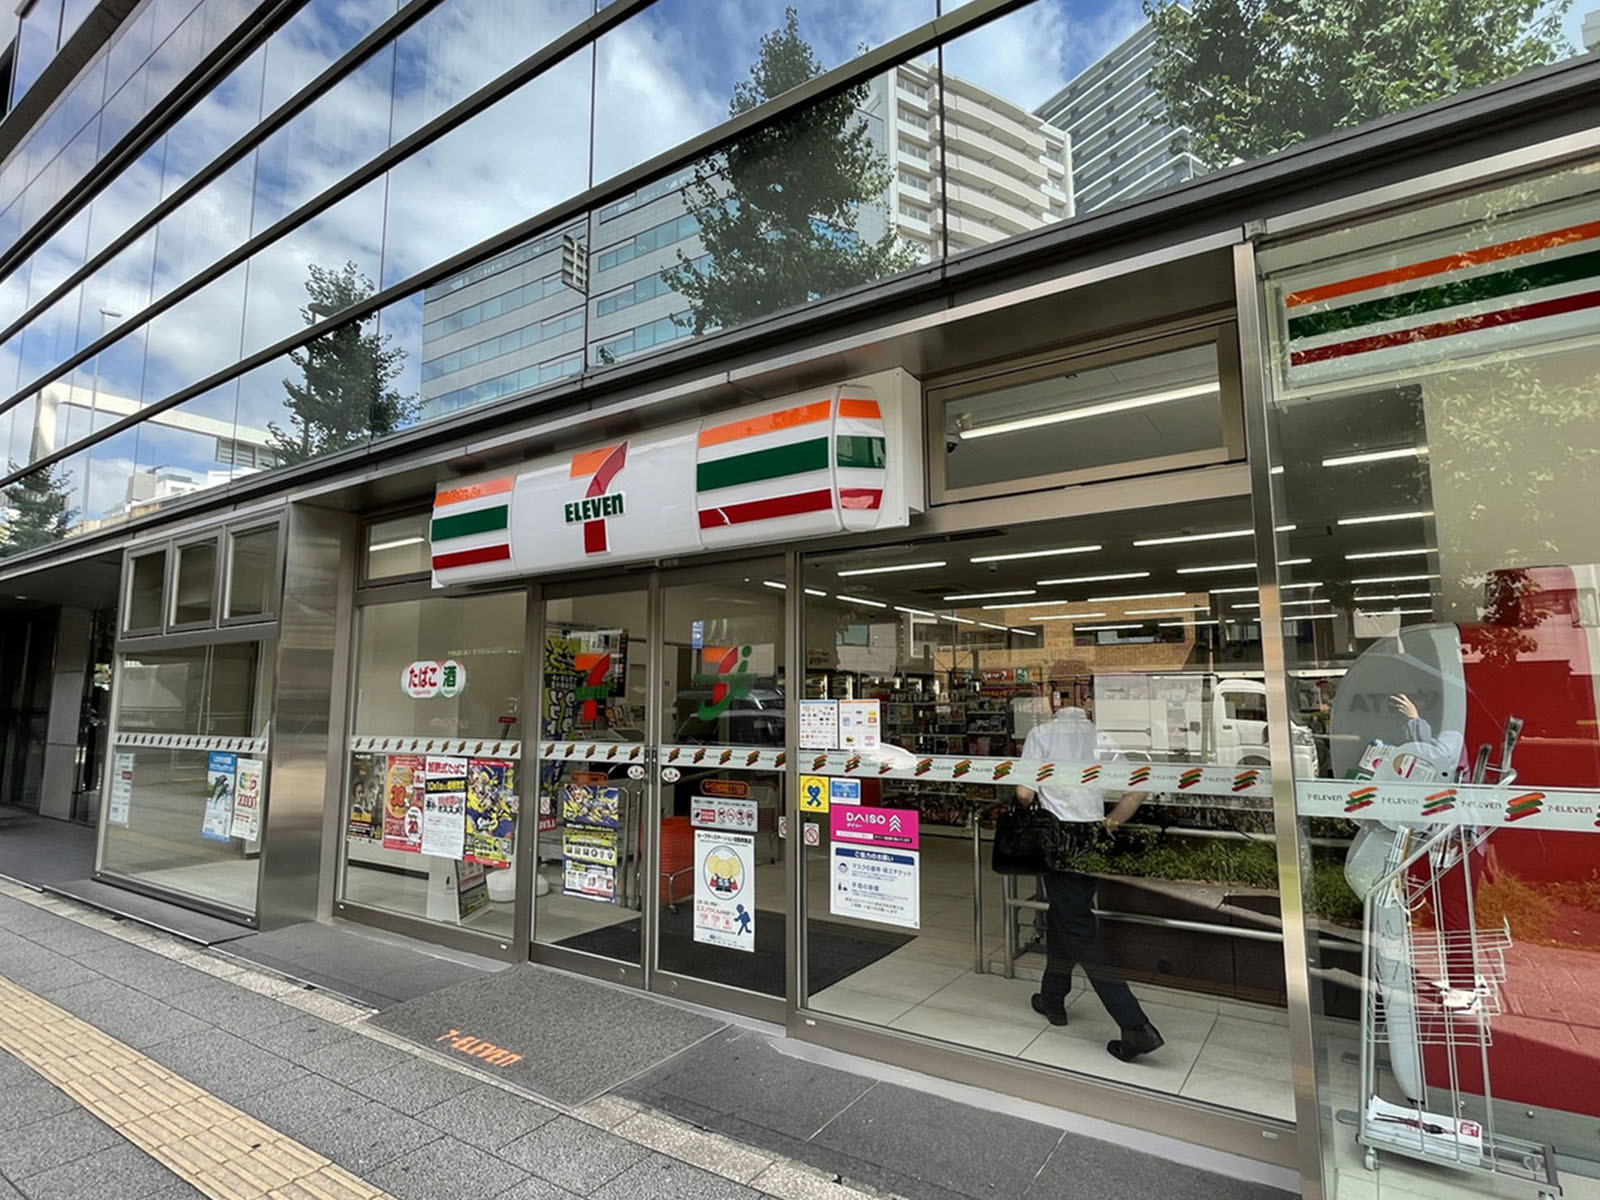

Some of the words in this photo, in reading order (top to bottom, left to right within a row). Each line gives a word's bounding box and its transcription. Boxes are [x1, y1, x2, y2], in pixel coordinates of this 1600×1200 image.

[569, 440, 628, 554] 7
[408, 666, 437, 688] たばこ
[442, 665, 457, 688] 酒
[846, 812, 886, 824] DAISO
